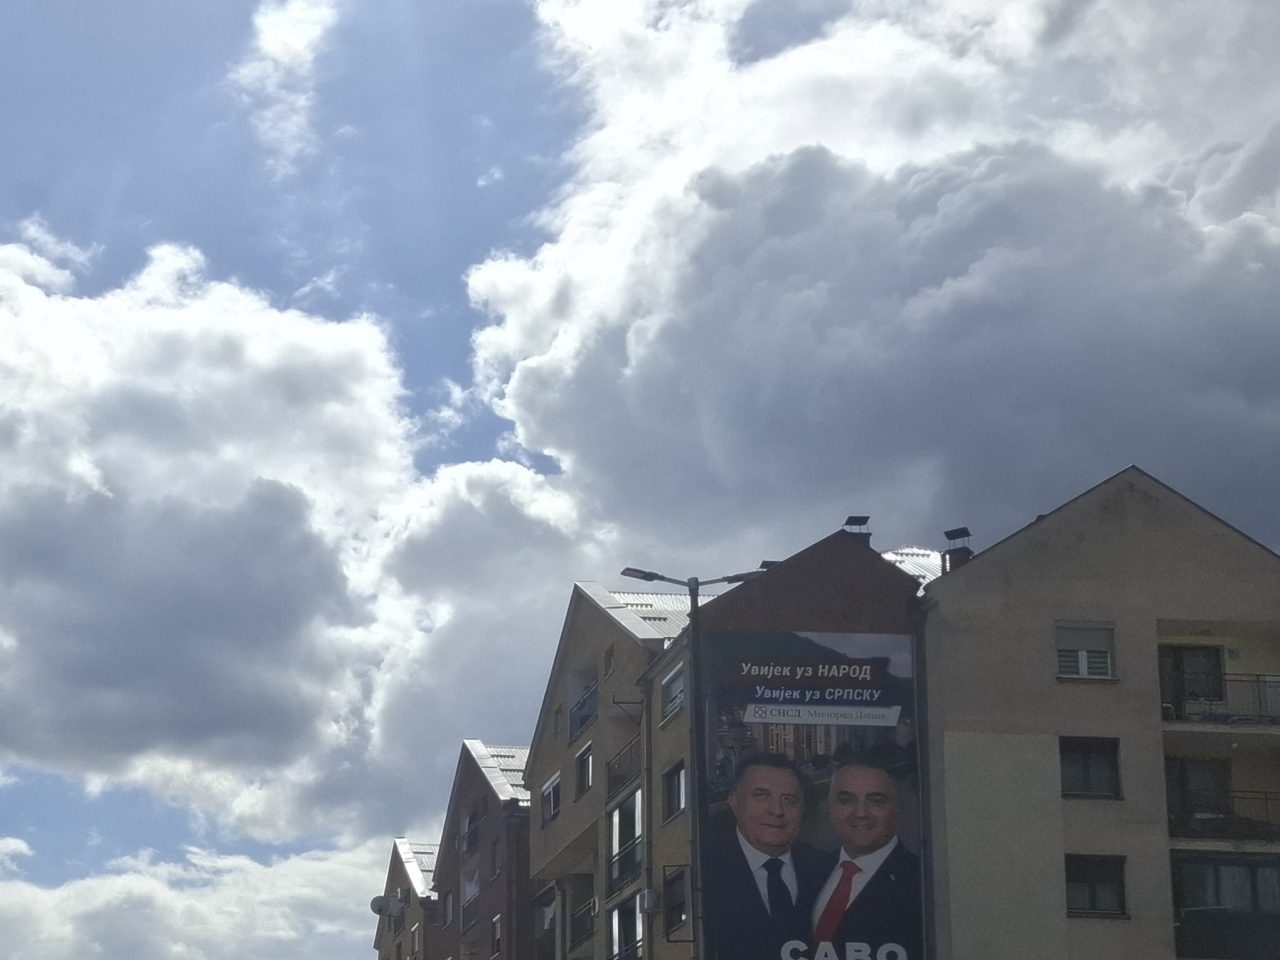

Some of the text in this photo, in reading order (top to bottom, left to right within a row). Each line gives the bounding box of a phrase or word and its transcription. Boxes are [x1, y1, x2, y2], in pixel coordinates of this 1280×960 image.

[740, 662, 872, 680] Увијек уз НАРОД
[754, 685, 882, 702] Увијек уз СРПСКУ
